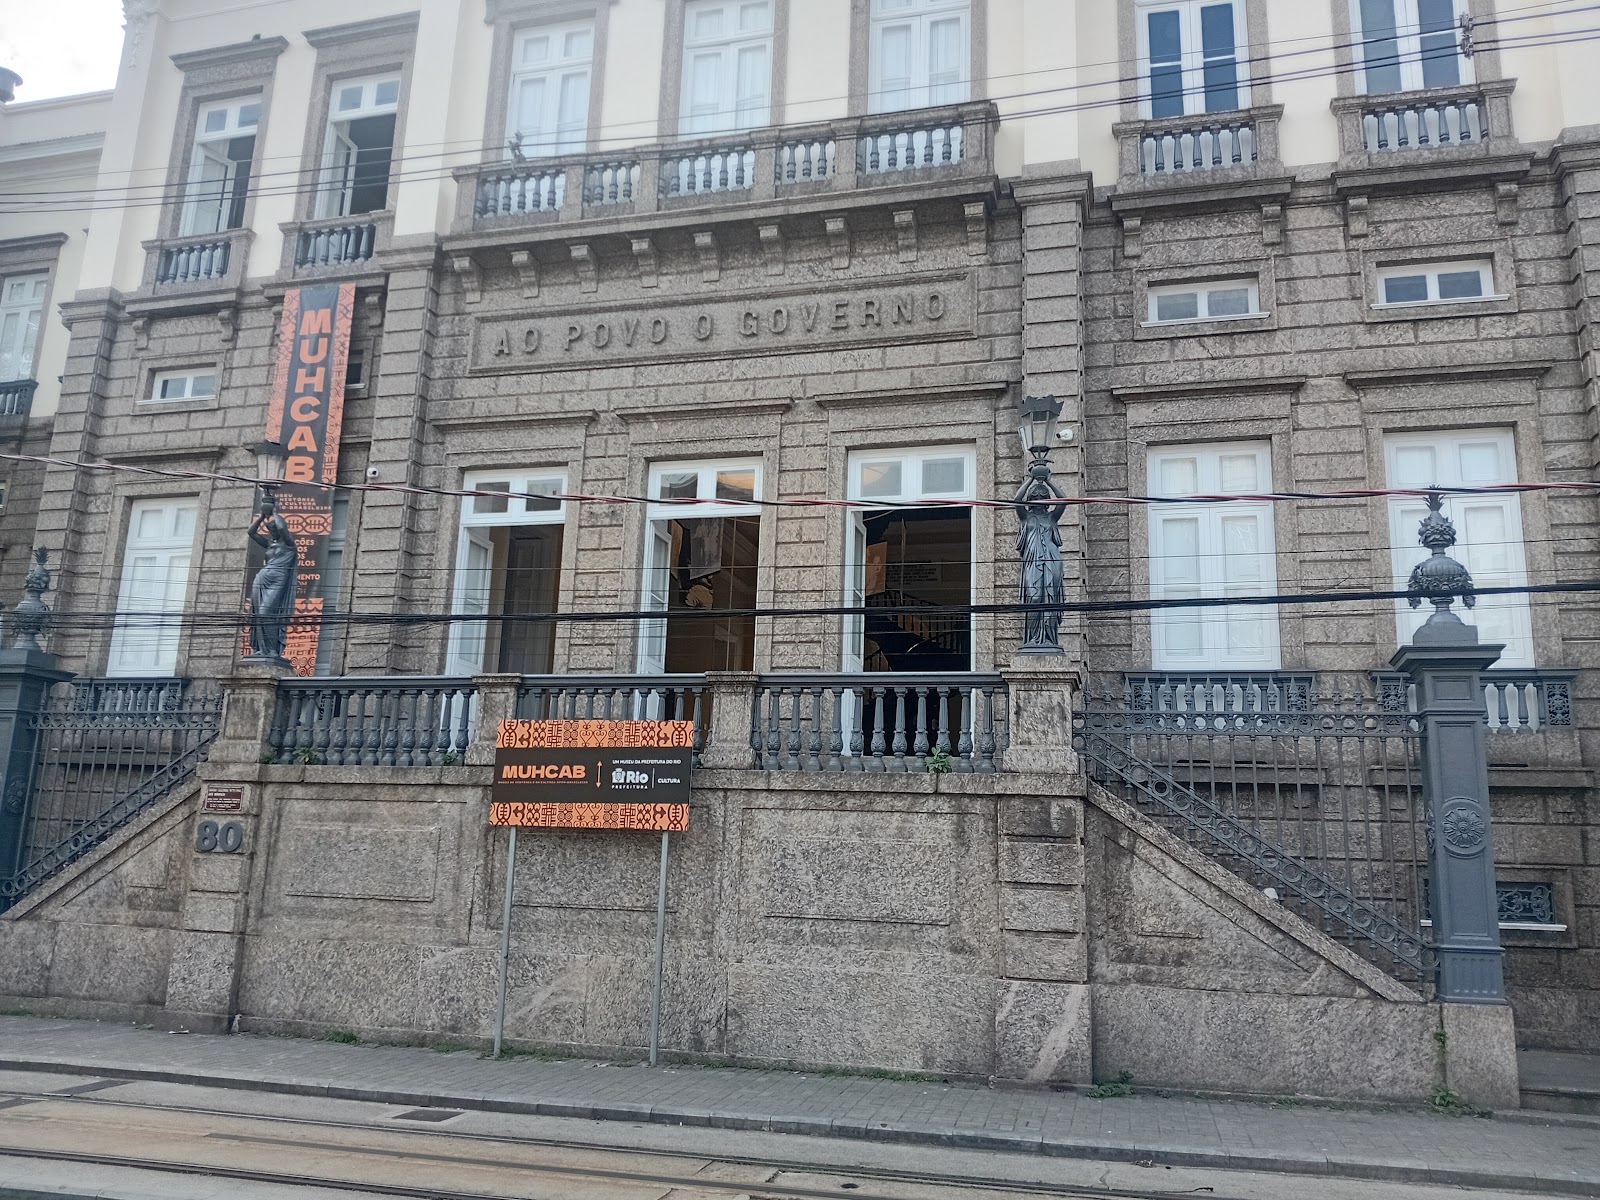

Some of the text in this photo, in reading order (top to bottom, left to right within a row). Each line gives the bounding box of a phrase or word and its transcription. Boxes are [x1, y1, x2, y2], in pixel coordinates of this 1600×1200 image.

[494, 291, 949, 356] AO POVO O GOVERNO
[284, 308, 332, 482] MUHCAB
[502, 764, 586, 779] MUHCAB
[626, 770, 649, 784] Rio
[195, 820, 243, 852] 80
